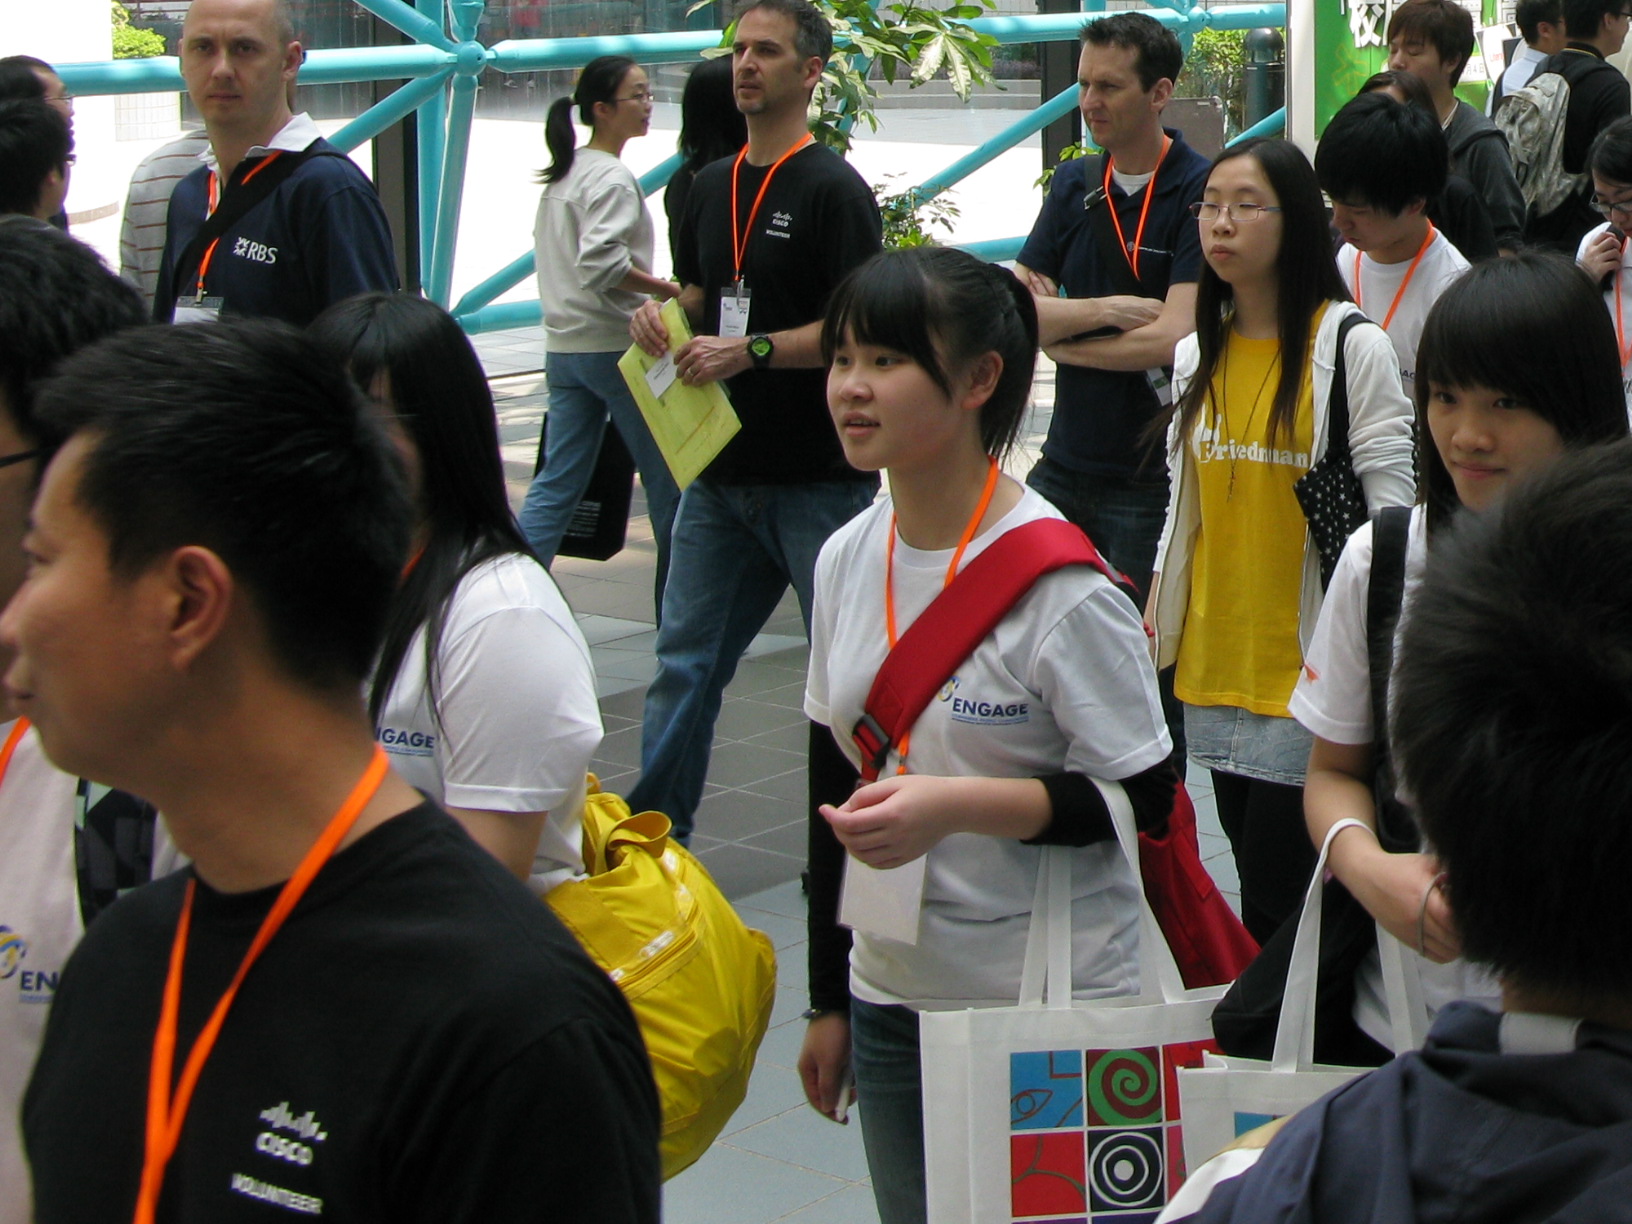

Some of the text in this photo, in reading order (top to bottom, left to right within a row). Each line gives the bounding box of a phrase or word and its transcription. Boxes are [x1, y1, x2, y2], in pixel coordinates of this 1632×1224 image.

[246, 241, 278, 264] RBS
[952, 697, 1029, 718] ENGAGE
[256, 1131, 314, 1166] CISCO
[231, 1172, 324, 1215] VOLUNTEER
